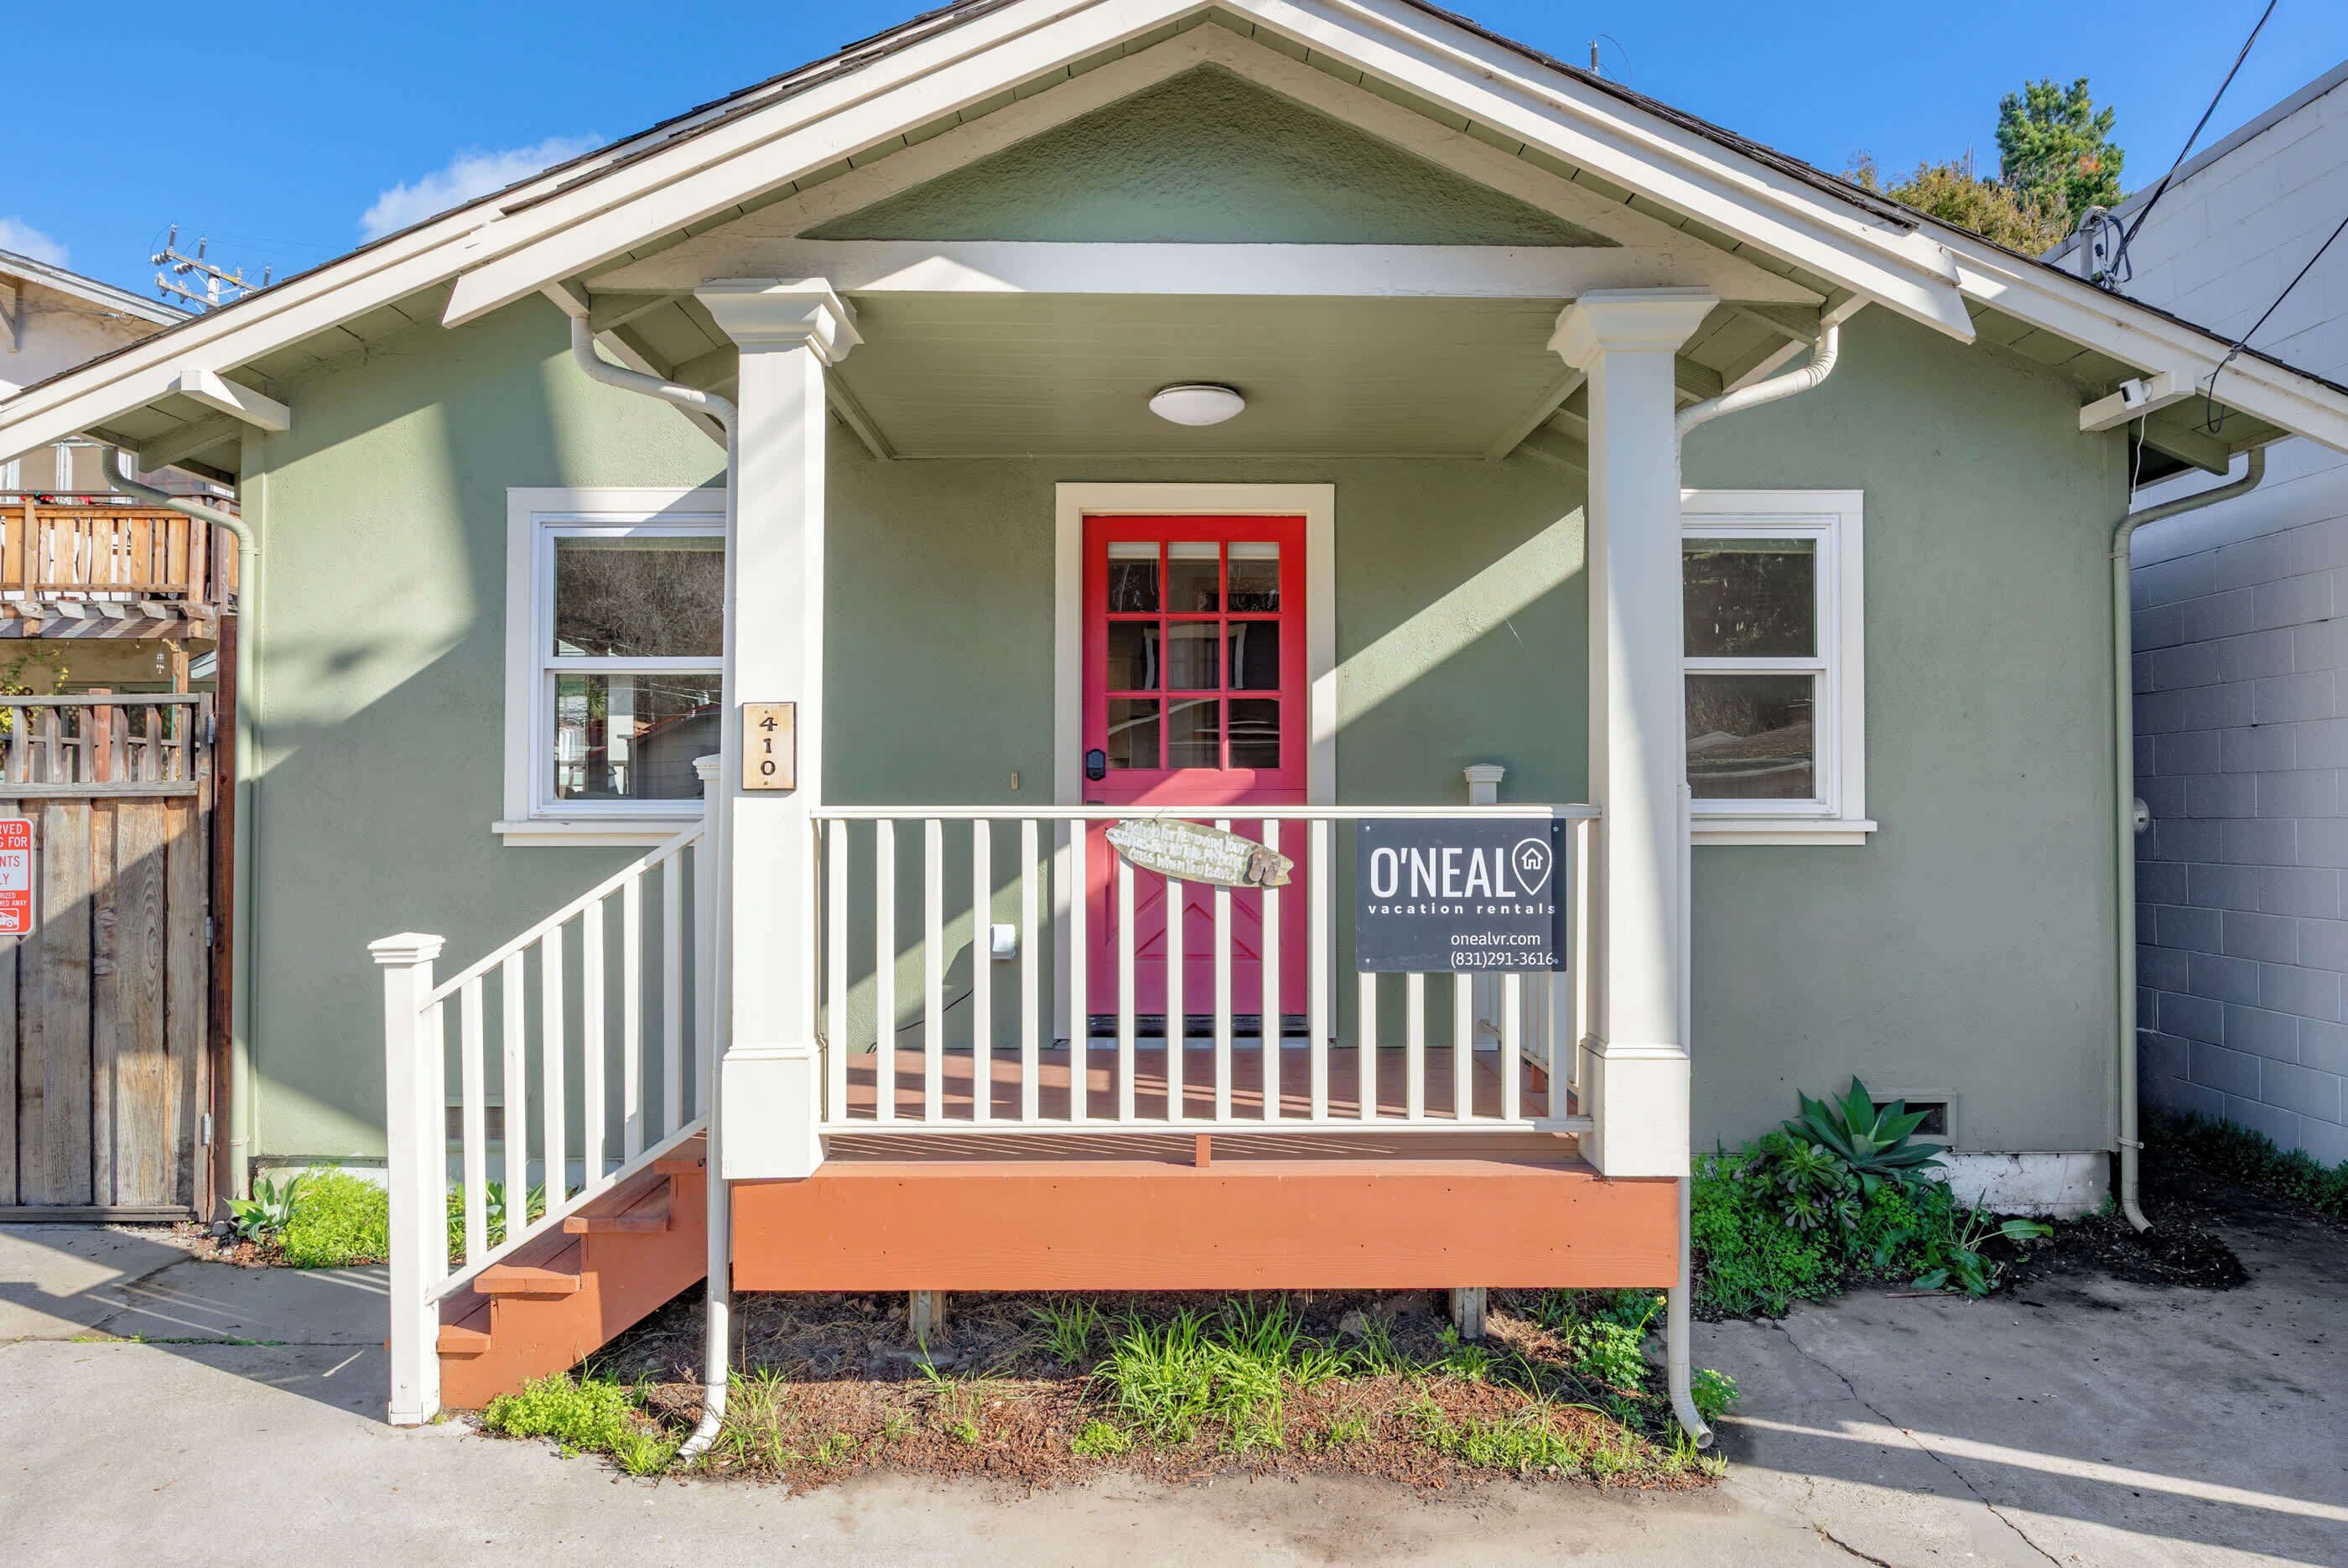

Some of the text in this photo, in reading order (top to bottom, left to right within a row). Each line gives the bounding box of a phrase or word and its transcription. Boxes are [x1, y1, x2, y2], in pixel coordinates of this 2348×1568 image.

[759, 717, 778, 776] 410
[8, 836, 28, 847] FOR
[1370, 847, 1516, 898] O'NEAL
[1368, 902, 1556, 915] vacation rentals
[1451, 932, 1541, 946] onealvr.com
[1451, 951, 1554, 968] (831)291-3616
